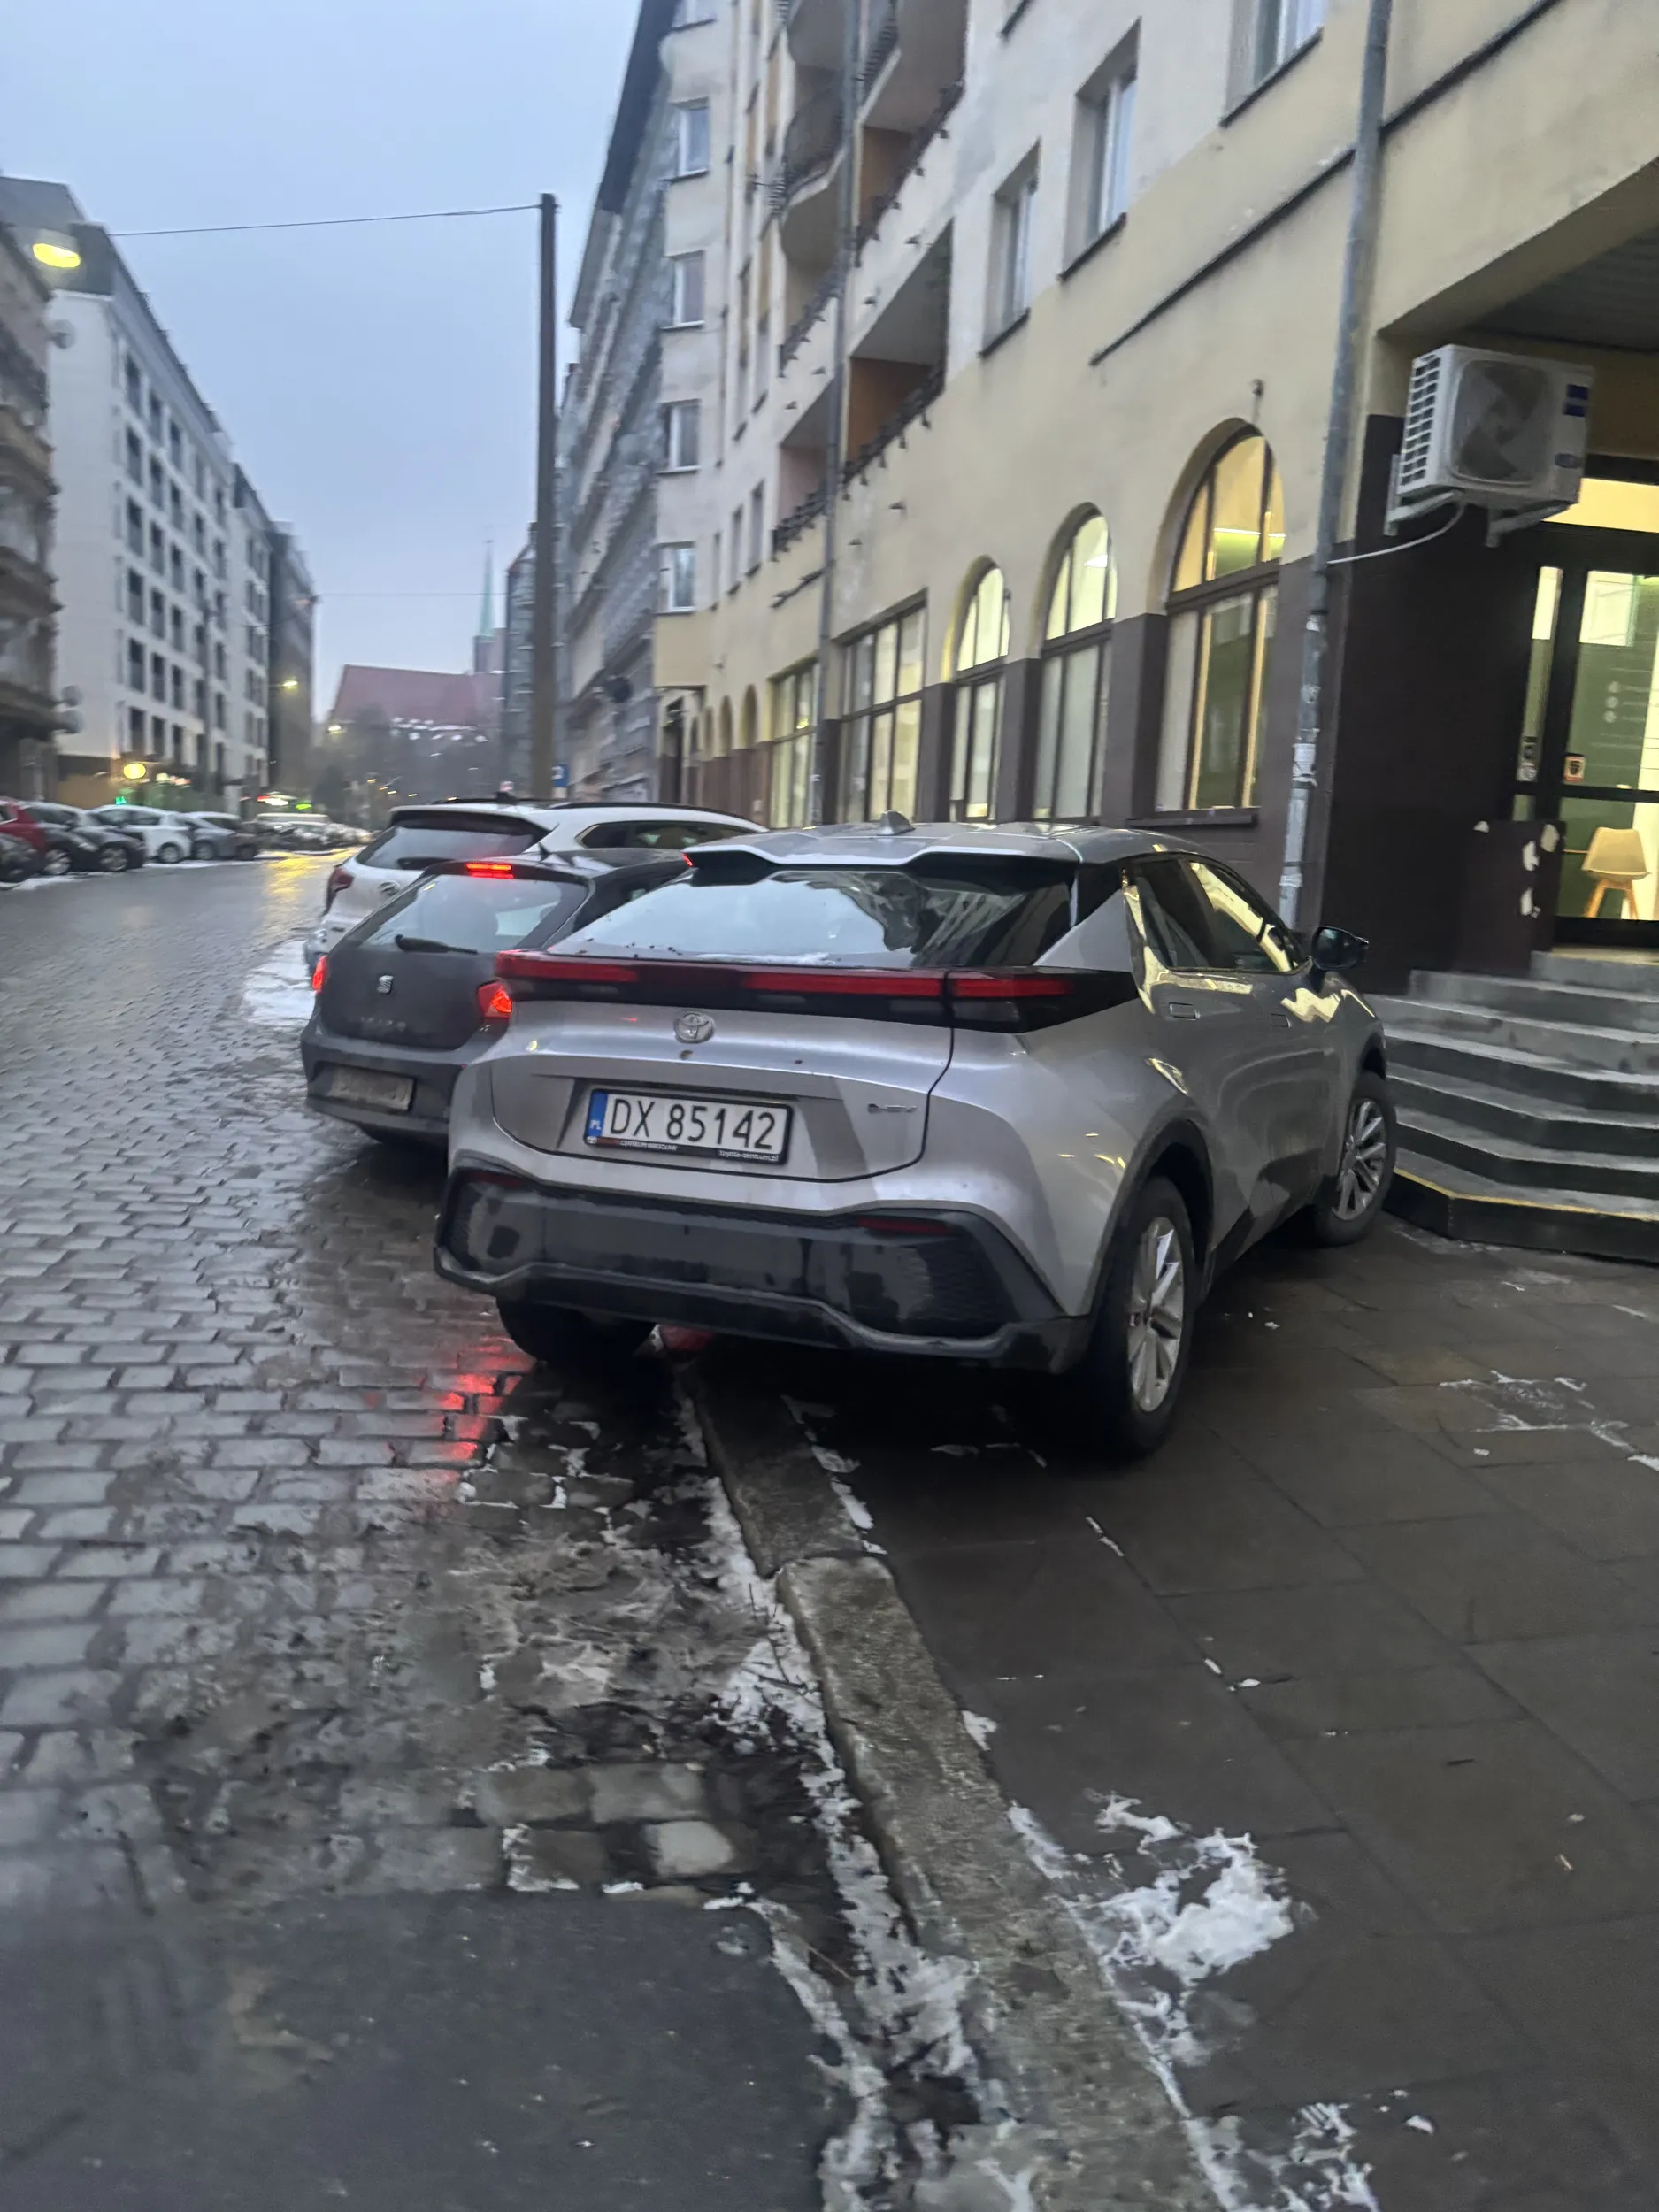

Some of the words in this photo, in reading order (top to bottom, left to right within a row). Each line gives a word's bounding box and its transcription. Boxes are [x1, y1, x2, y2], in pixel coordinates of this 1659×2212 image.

[589, 1119, 602, 1129] PL
[611, 1098, 655, 1137] DX
[666, 1104, 775, 1150] 85142
